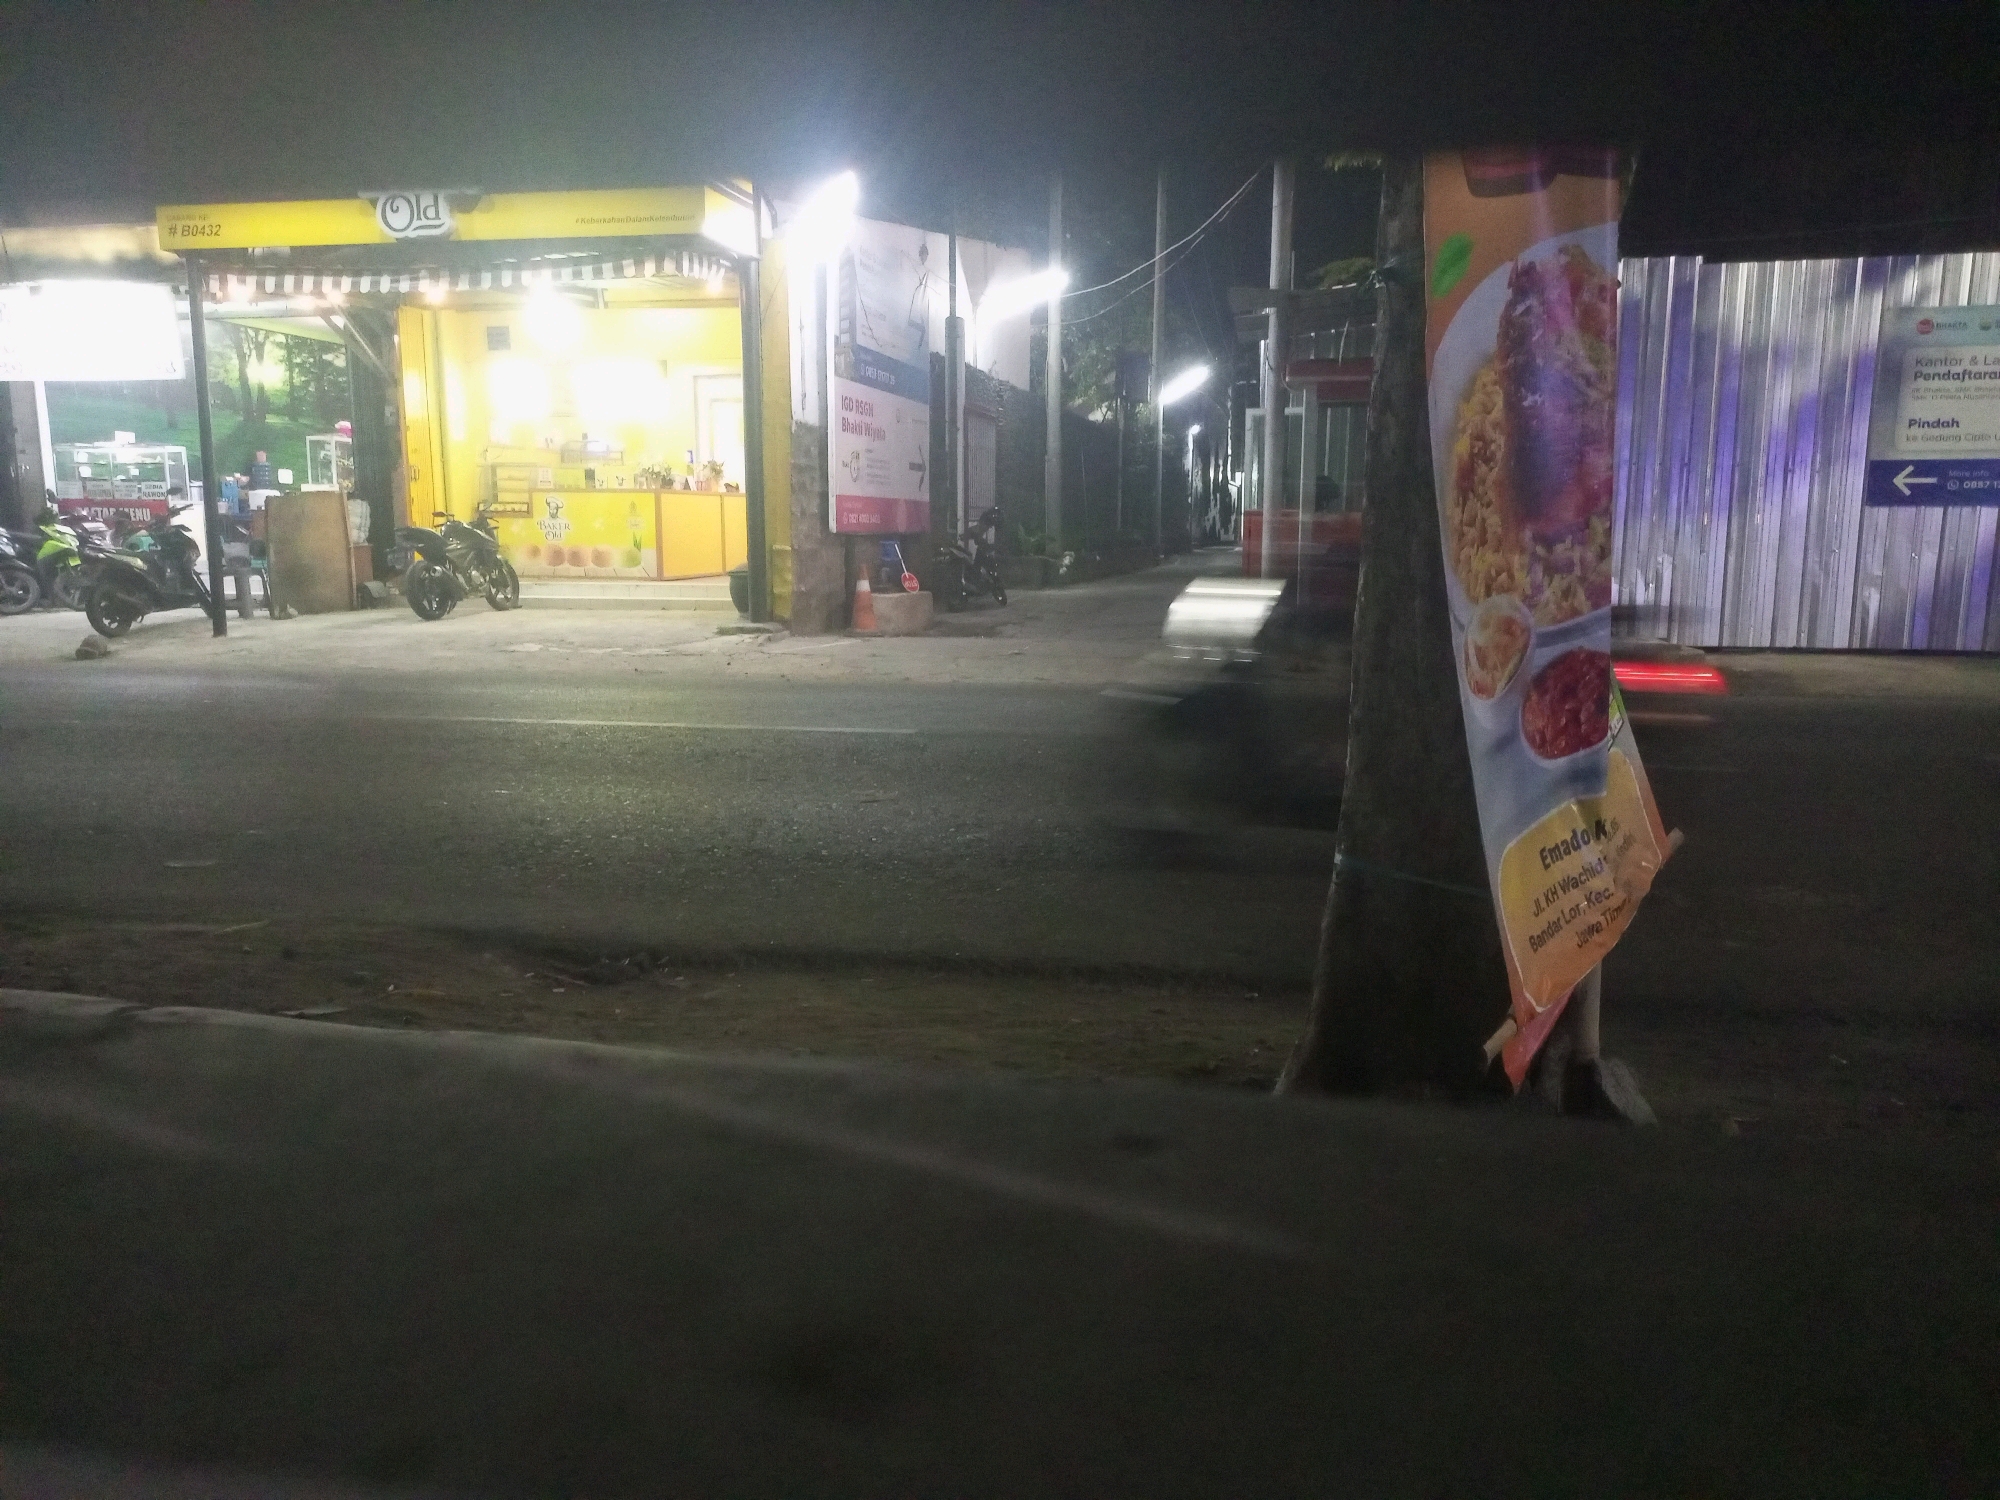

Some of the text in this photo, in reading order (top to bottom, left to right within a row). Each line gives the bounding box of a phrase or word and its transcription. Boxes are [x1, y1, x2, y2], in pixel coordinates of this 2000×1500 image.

[181, 223, 222, 236] B0432
[1915, 356, 1963, 367] Kantor
[841, 417, 863, 436] Bhakti
[1908, 418, 1960, 429] Pindah
[537, 519, 571, 531] BAKER
[545, 530, 562, 541] Old
[1539, 828, 1591, 871] Emado
[1543, 885, 1559, 908] KH
[1558, 857, 1605, 895] Wachid
[1528, 915, 1563, 954] Bandar
[1584, 887, 1614, 909] Kec.
[1575, 921, 1604, 948] Jawa
